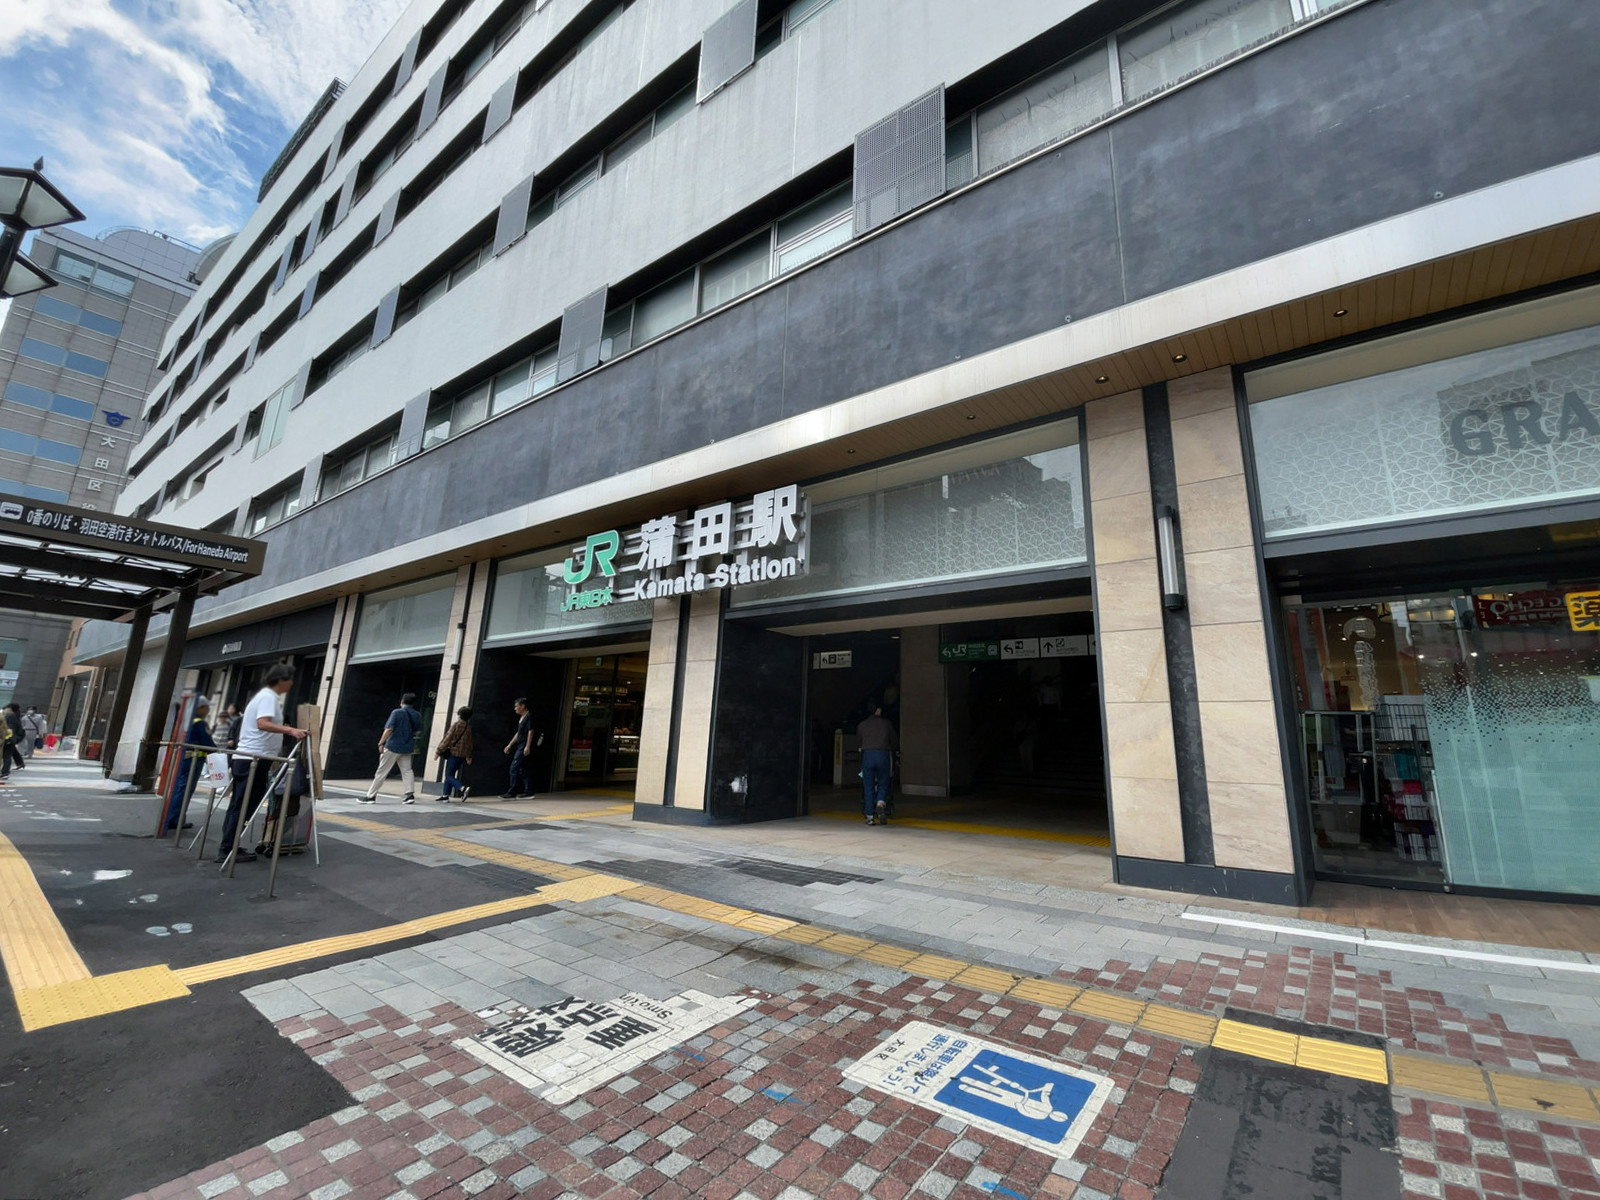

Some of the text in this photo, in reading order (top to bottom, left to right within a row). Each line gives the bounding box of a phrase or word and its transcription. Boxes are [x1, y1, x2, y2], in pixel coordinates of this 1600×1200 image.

[1450, 391, 1600, 455] GRA
[198, 542, 223, 558] Haneda
[223, 548, 248, 563] Airport
[563, 484, 797, 584] JR 蒲田駅
[560, 587, 613, 612] JR東日本
[634, 555, 796, 601] Kamata Station
[873, 1038, 906, 1061] 大田区
[902, 1038, 969, 1095] 自転車は降りて
